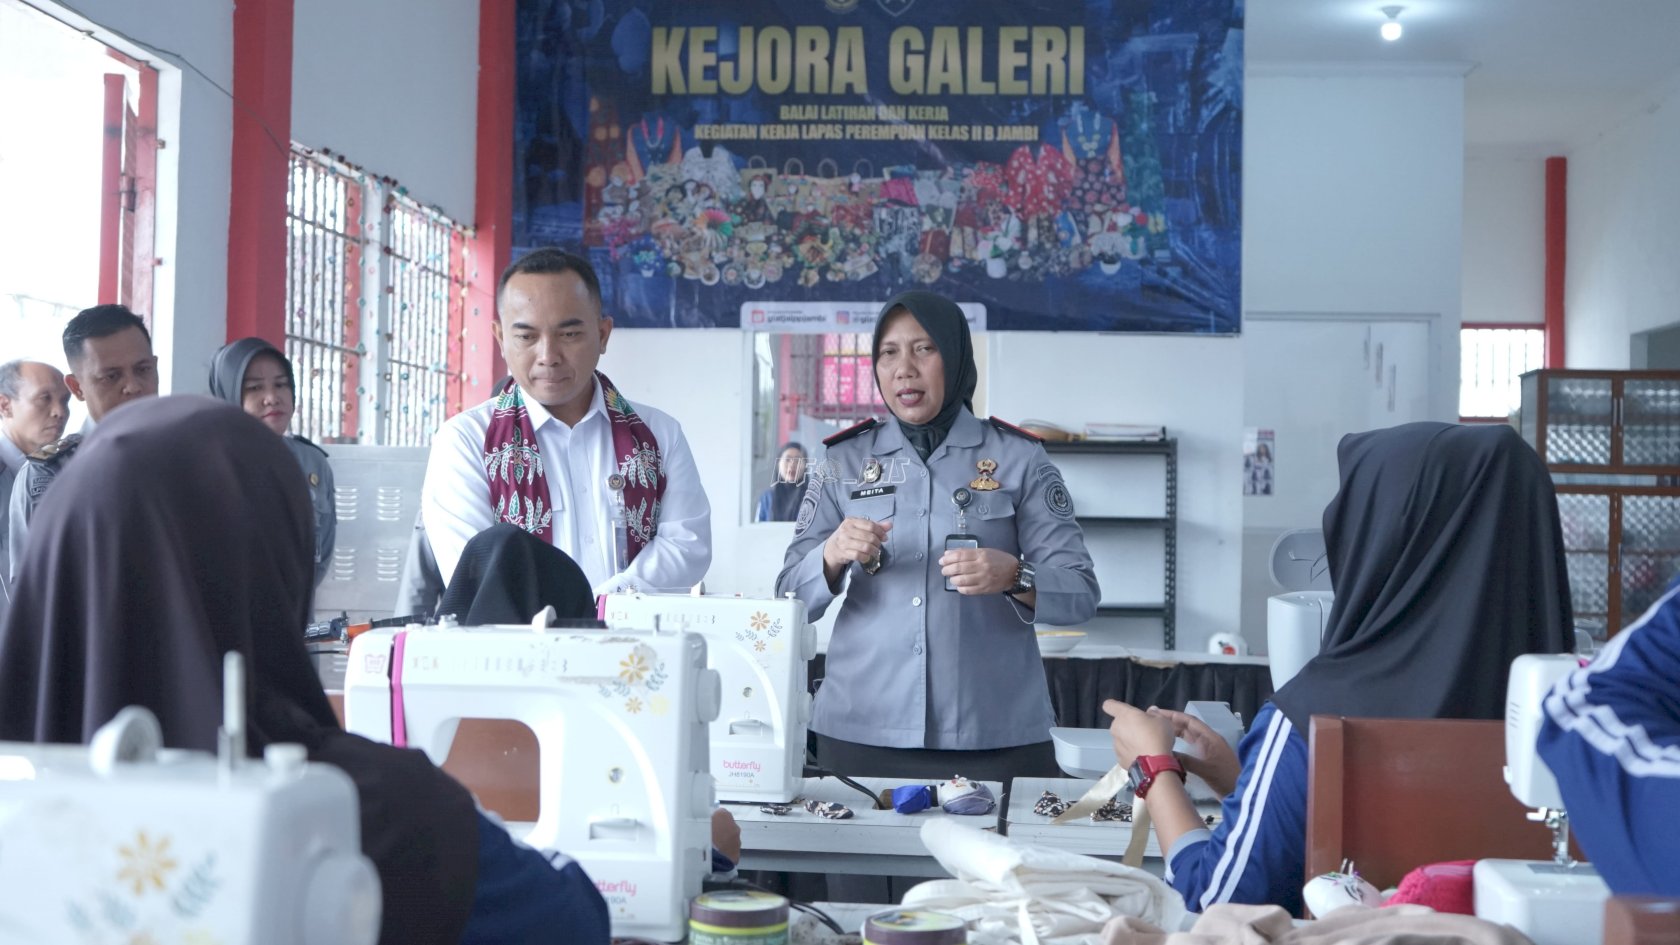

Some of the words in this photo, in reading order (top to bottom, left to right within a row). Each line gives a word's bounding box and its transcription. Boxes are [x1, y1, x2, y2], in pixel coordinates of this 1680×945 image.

[651, 26, 868, 95] KEJORA
[888, 26, 1085, 96] GALERI
[780, 105, 818, 120] BALAI
[821, 105, 876, 121] LATIHAN
[878, 106, 906, 121] DAN
[908, 106, 949, 121] KERJA
[694, 124, 757, 140] KEGIATAN
[760, 124, 799, 140] KERJA
[802, 124, 843, 140] LAPAS
[845, 125, 926, 141] PEREMPUAN
[928, 125, 969, 141] KELAS
[971, 125, 982, 141] II
[984, 126, 994, 141] B
[996, 126, 1039, 142] JAMBI
[860, 488, 884, 497] MEITA
[723, 760, 761, 773] butterfly
